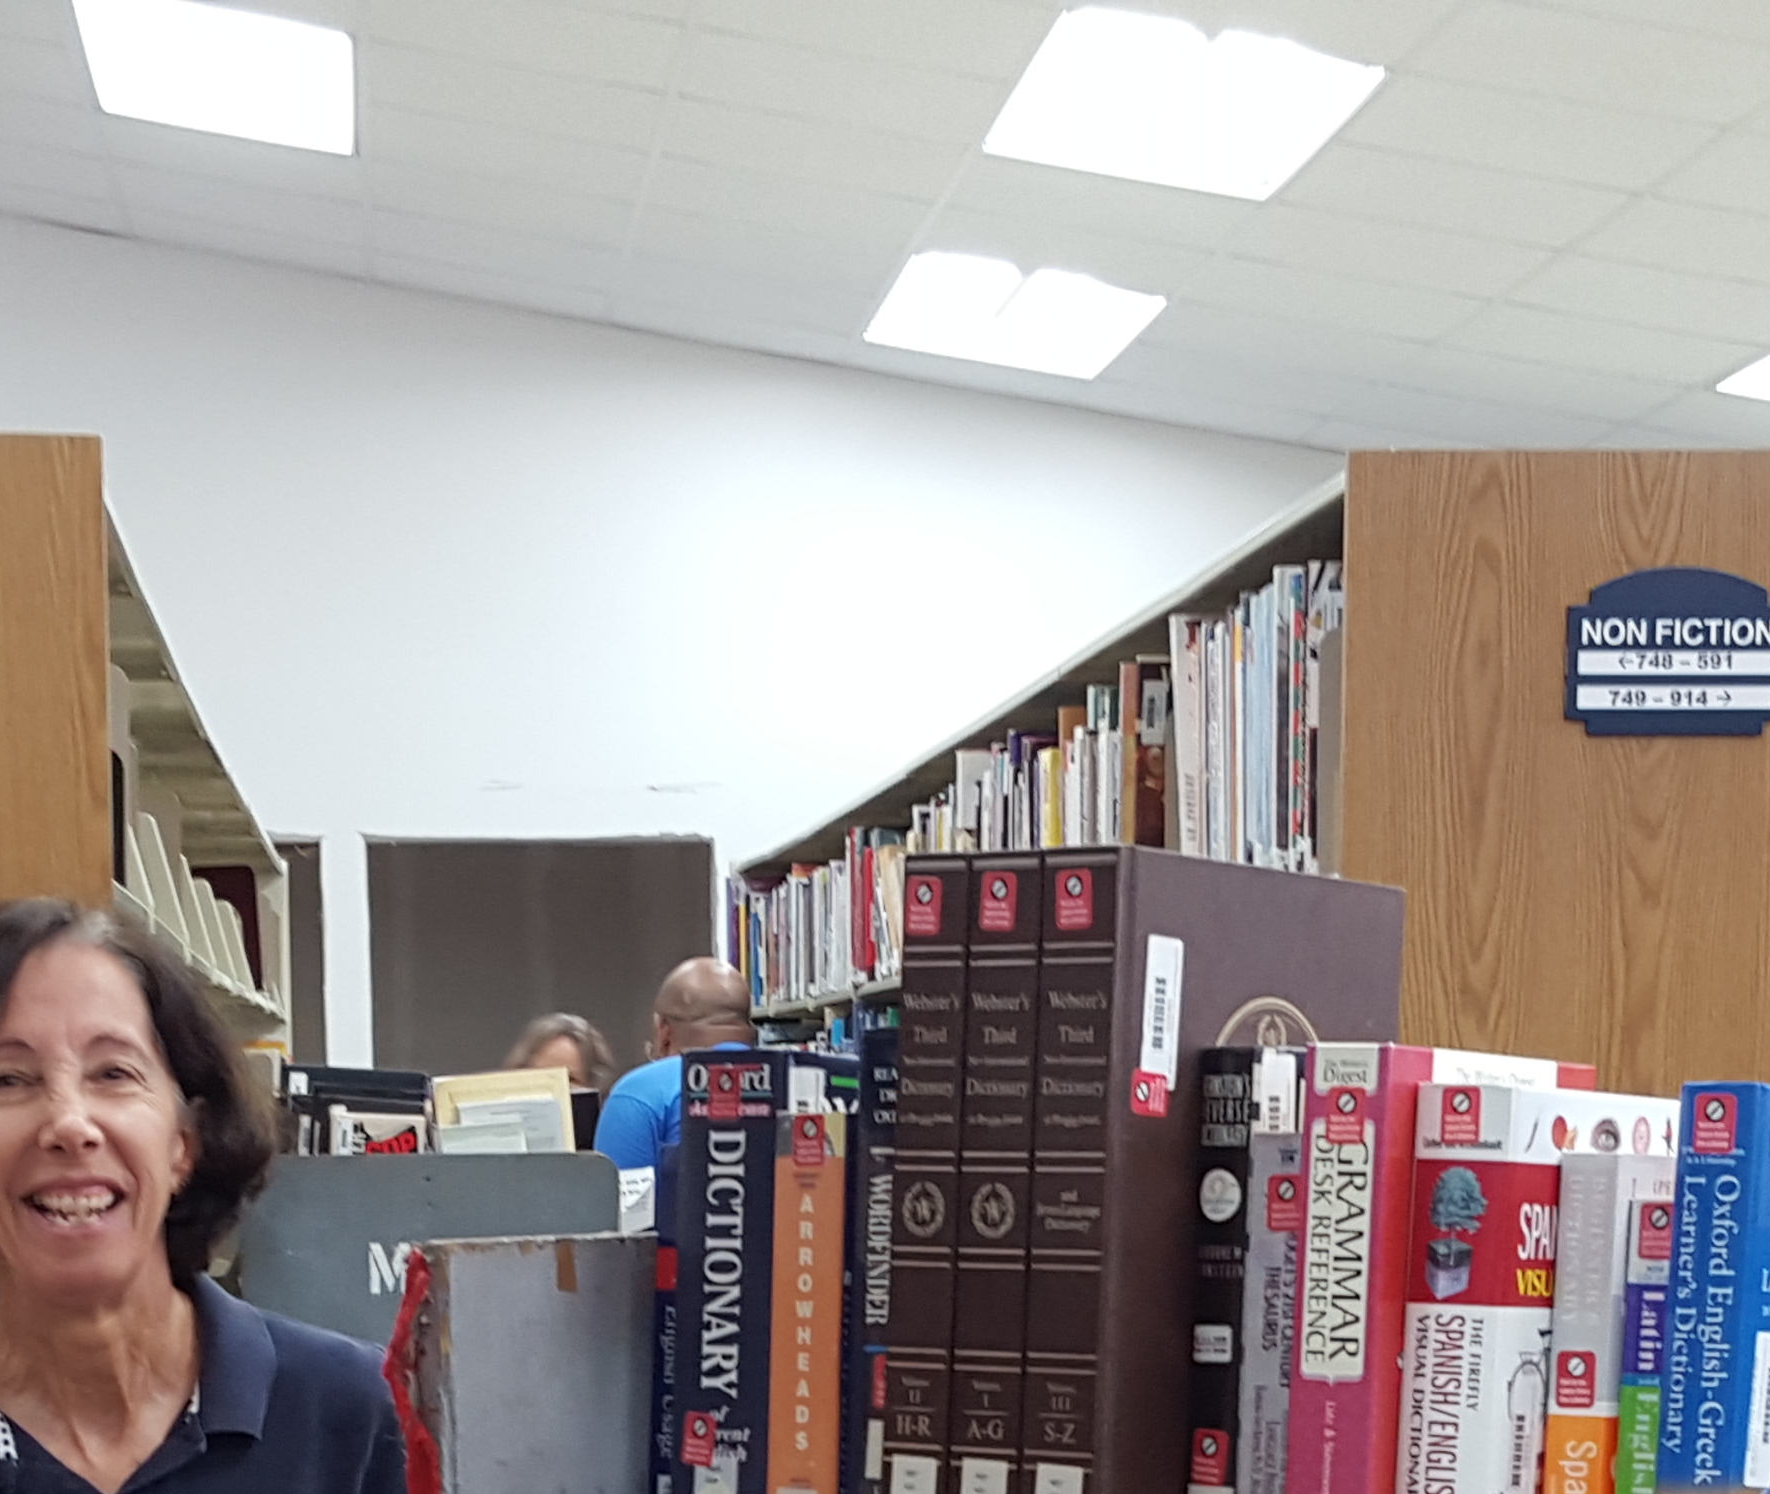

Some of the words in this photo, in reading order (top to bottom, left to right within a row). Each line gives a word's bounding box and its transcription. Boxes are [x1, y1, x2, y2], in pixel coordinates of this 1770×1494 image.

[1581, 617, 1647, 646] NON
[1636, 653, 1674, 670] 748
[1697, 653, 1734, 670] 591
[1609, 689, 1647, 707] 749
[1670, 689, 1708, 707] 914
[1047, 990, 1108, 1010] Webster's
[913, 1025, 948, 1044] Third
[983, 1024, 1017, 1045] Third
[1058, 1024, 1095, 1044] Third
[1322, 1066, 1368, 1085] Digest
[1314, 1134, 1335, 1206] DESK
[864, 1174, 894, 1326] WORDFINDER
[1329, 1140, 1370, 1361] GRAMMAR
[1677, 1175, 1707, 1300] Learner's
[1708, 1174, 1742, 1278] Oxford
[699, 1129, 747, 1400] DICTIONARY
[1305, 1214, 1332, 1364] REFERENCE
[794, 1193, 815, 1451] ARROWHEADS
[1262, 1265, 1282, 1352] THESAURUS
[1468, 1318, 1484, 1348] THE
[1637, 1290, 1666, 1371] Latin
[1413, 1315, 1430, 1378] VISUAL
[1465, 1353, 1483, 1412] FIREFLY
[1661, 1306, 1697, 1455] Dictionary
[1692, 1287, 1735, 1486] English-Greek
[896, 1413, 932, 1437] H-R
[967, 1419, 1005, 1441] A-G
[1043, 1422, 1077, 1445] S-Z
